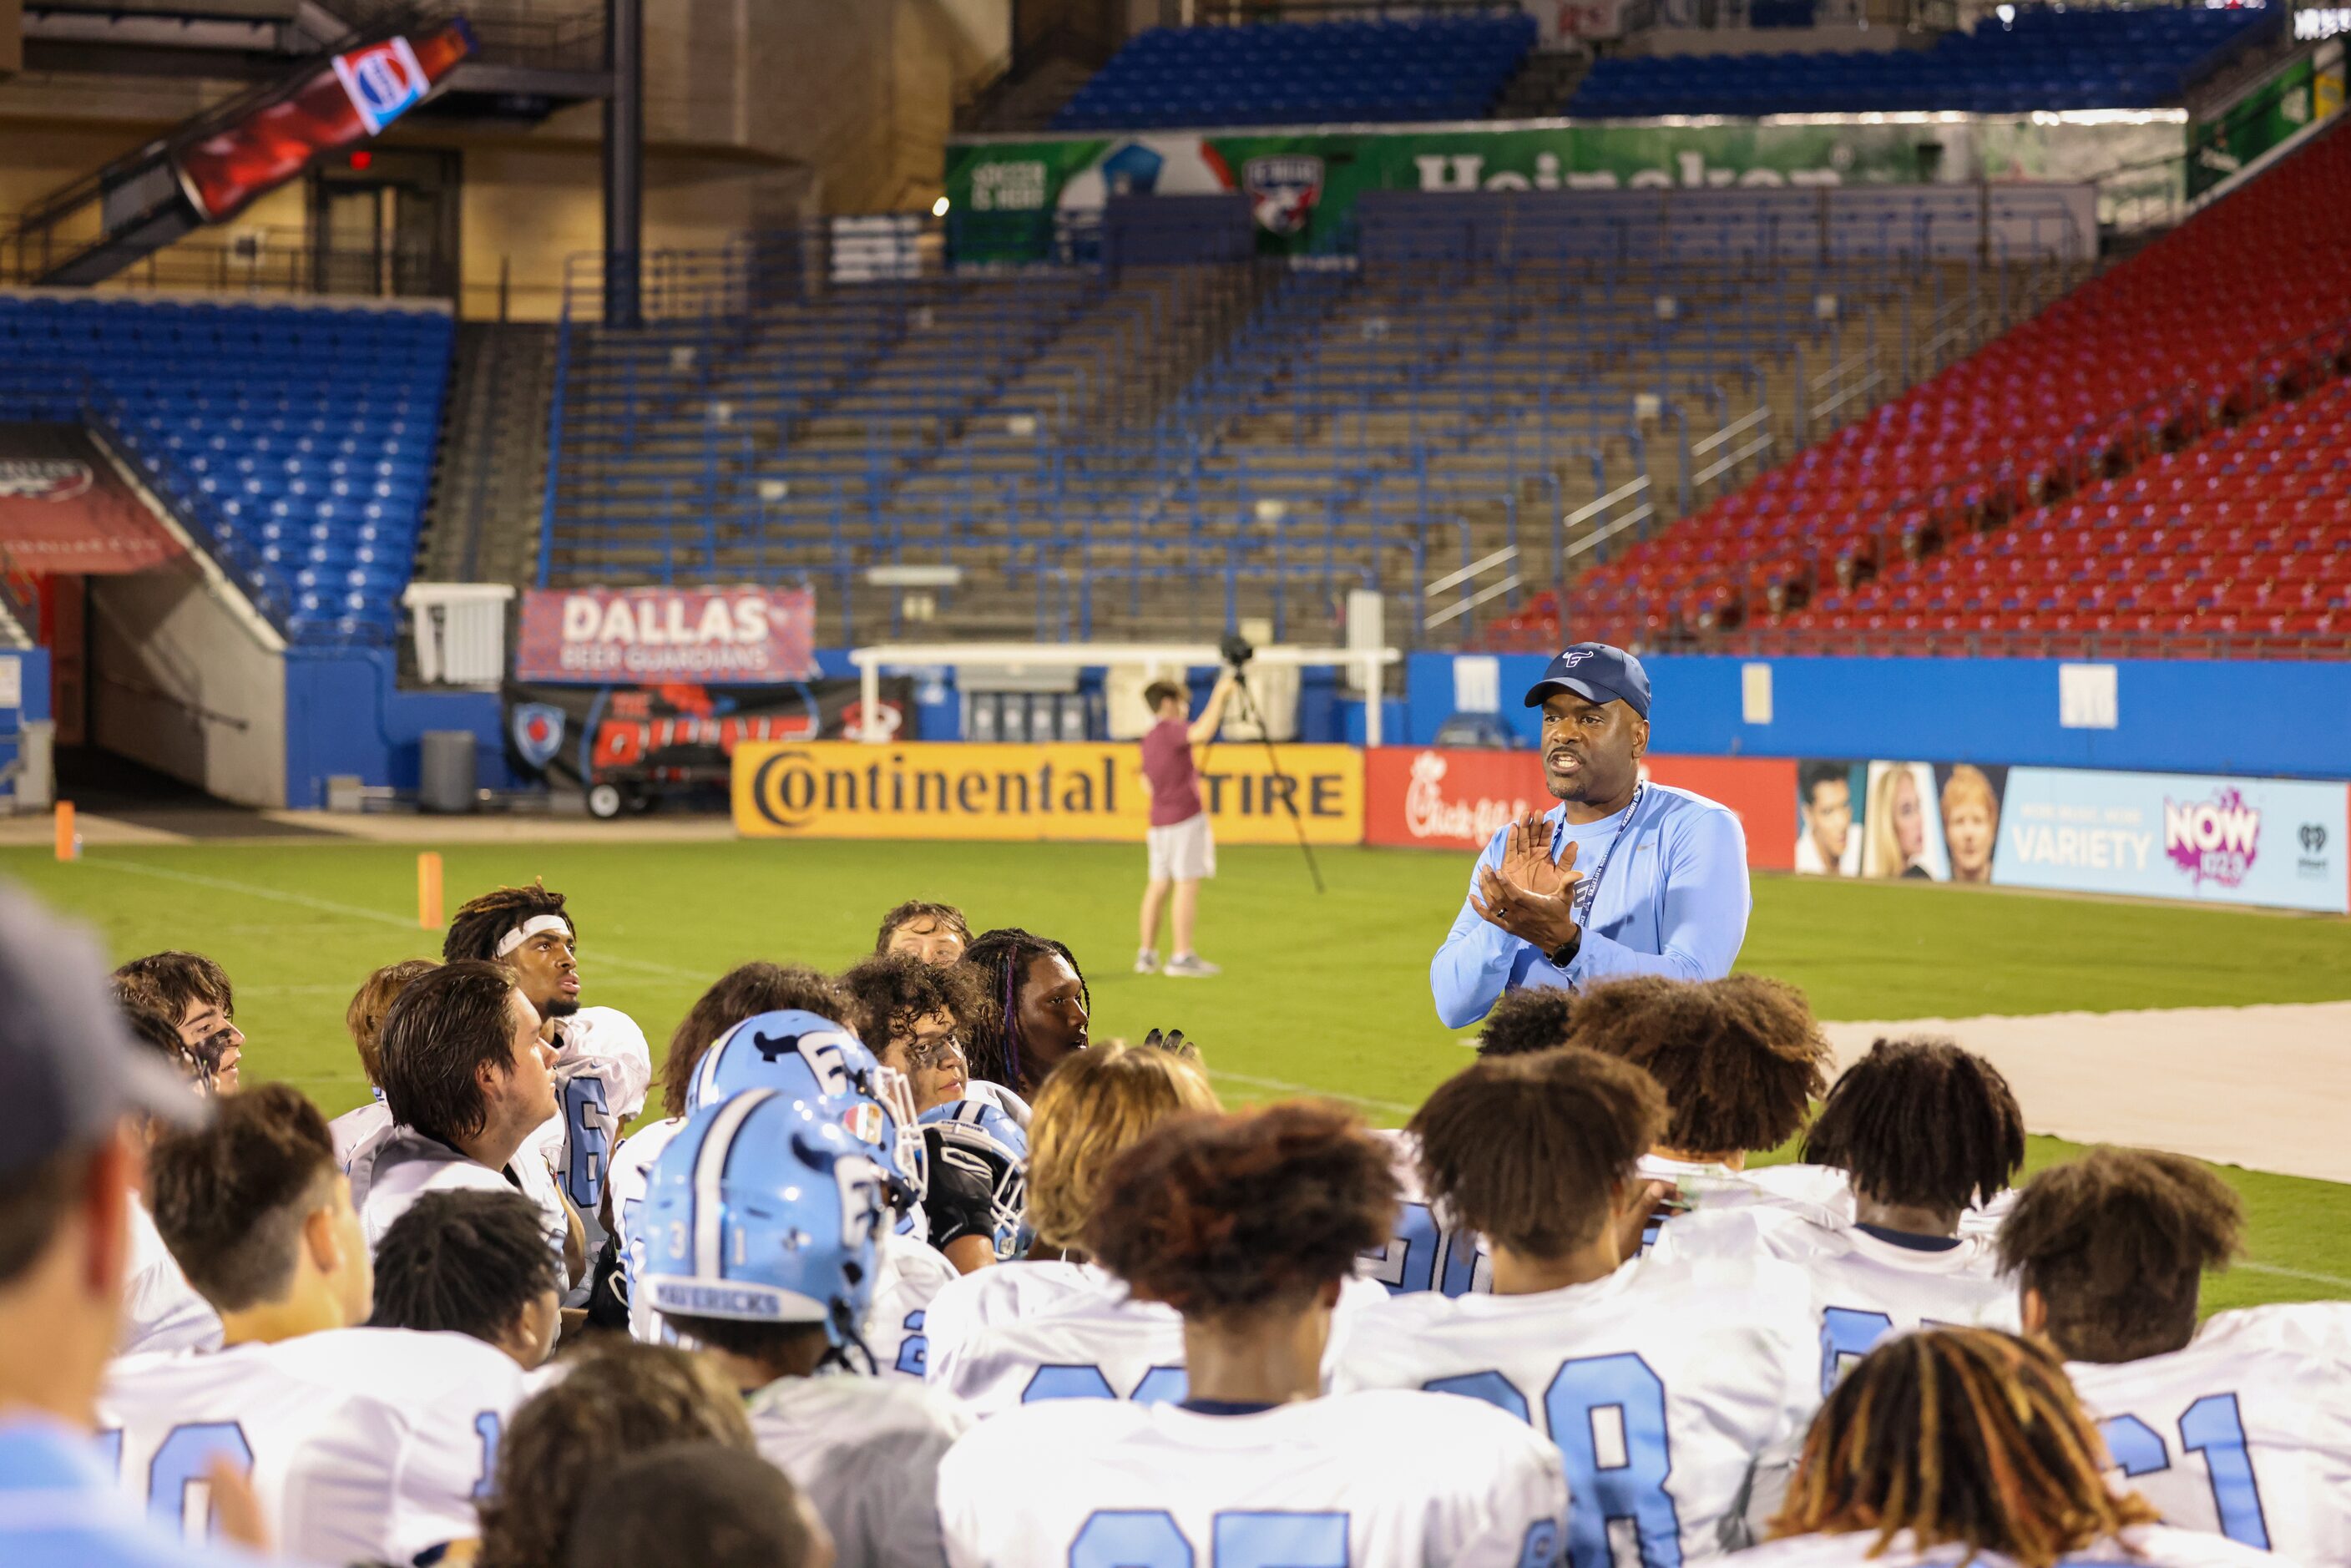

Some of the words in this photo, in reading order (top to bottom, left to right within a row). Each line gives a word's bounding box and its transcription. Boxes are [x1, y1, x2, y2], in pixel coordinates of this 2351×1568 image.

[563, 595, 770, 645] DALLAS
[560, 645, 621, 670] BEER
[753, 751, 1119, 828] Continental
[1201, 773, 1344, 817] TIRE
[2011, 824, 2152, 871] VARIETY
[2165, 802, 2259, 857] NOW
[1587, 867, 1603, 897] MAVERICKS
[657, 1283, 780, 1314] MAVERICKS
